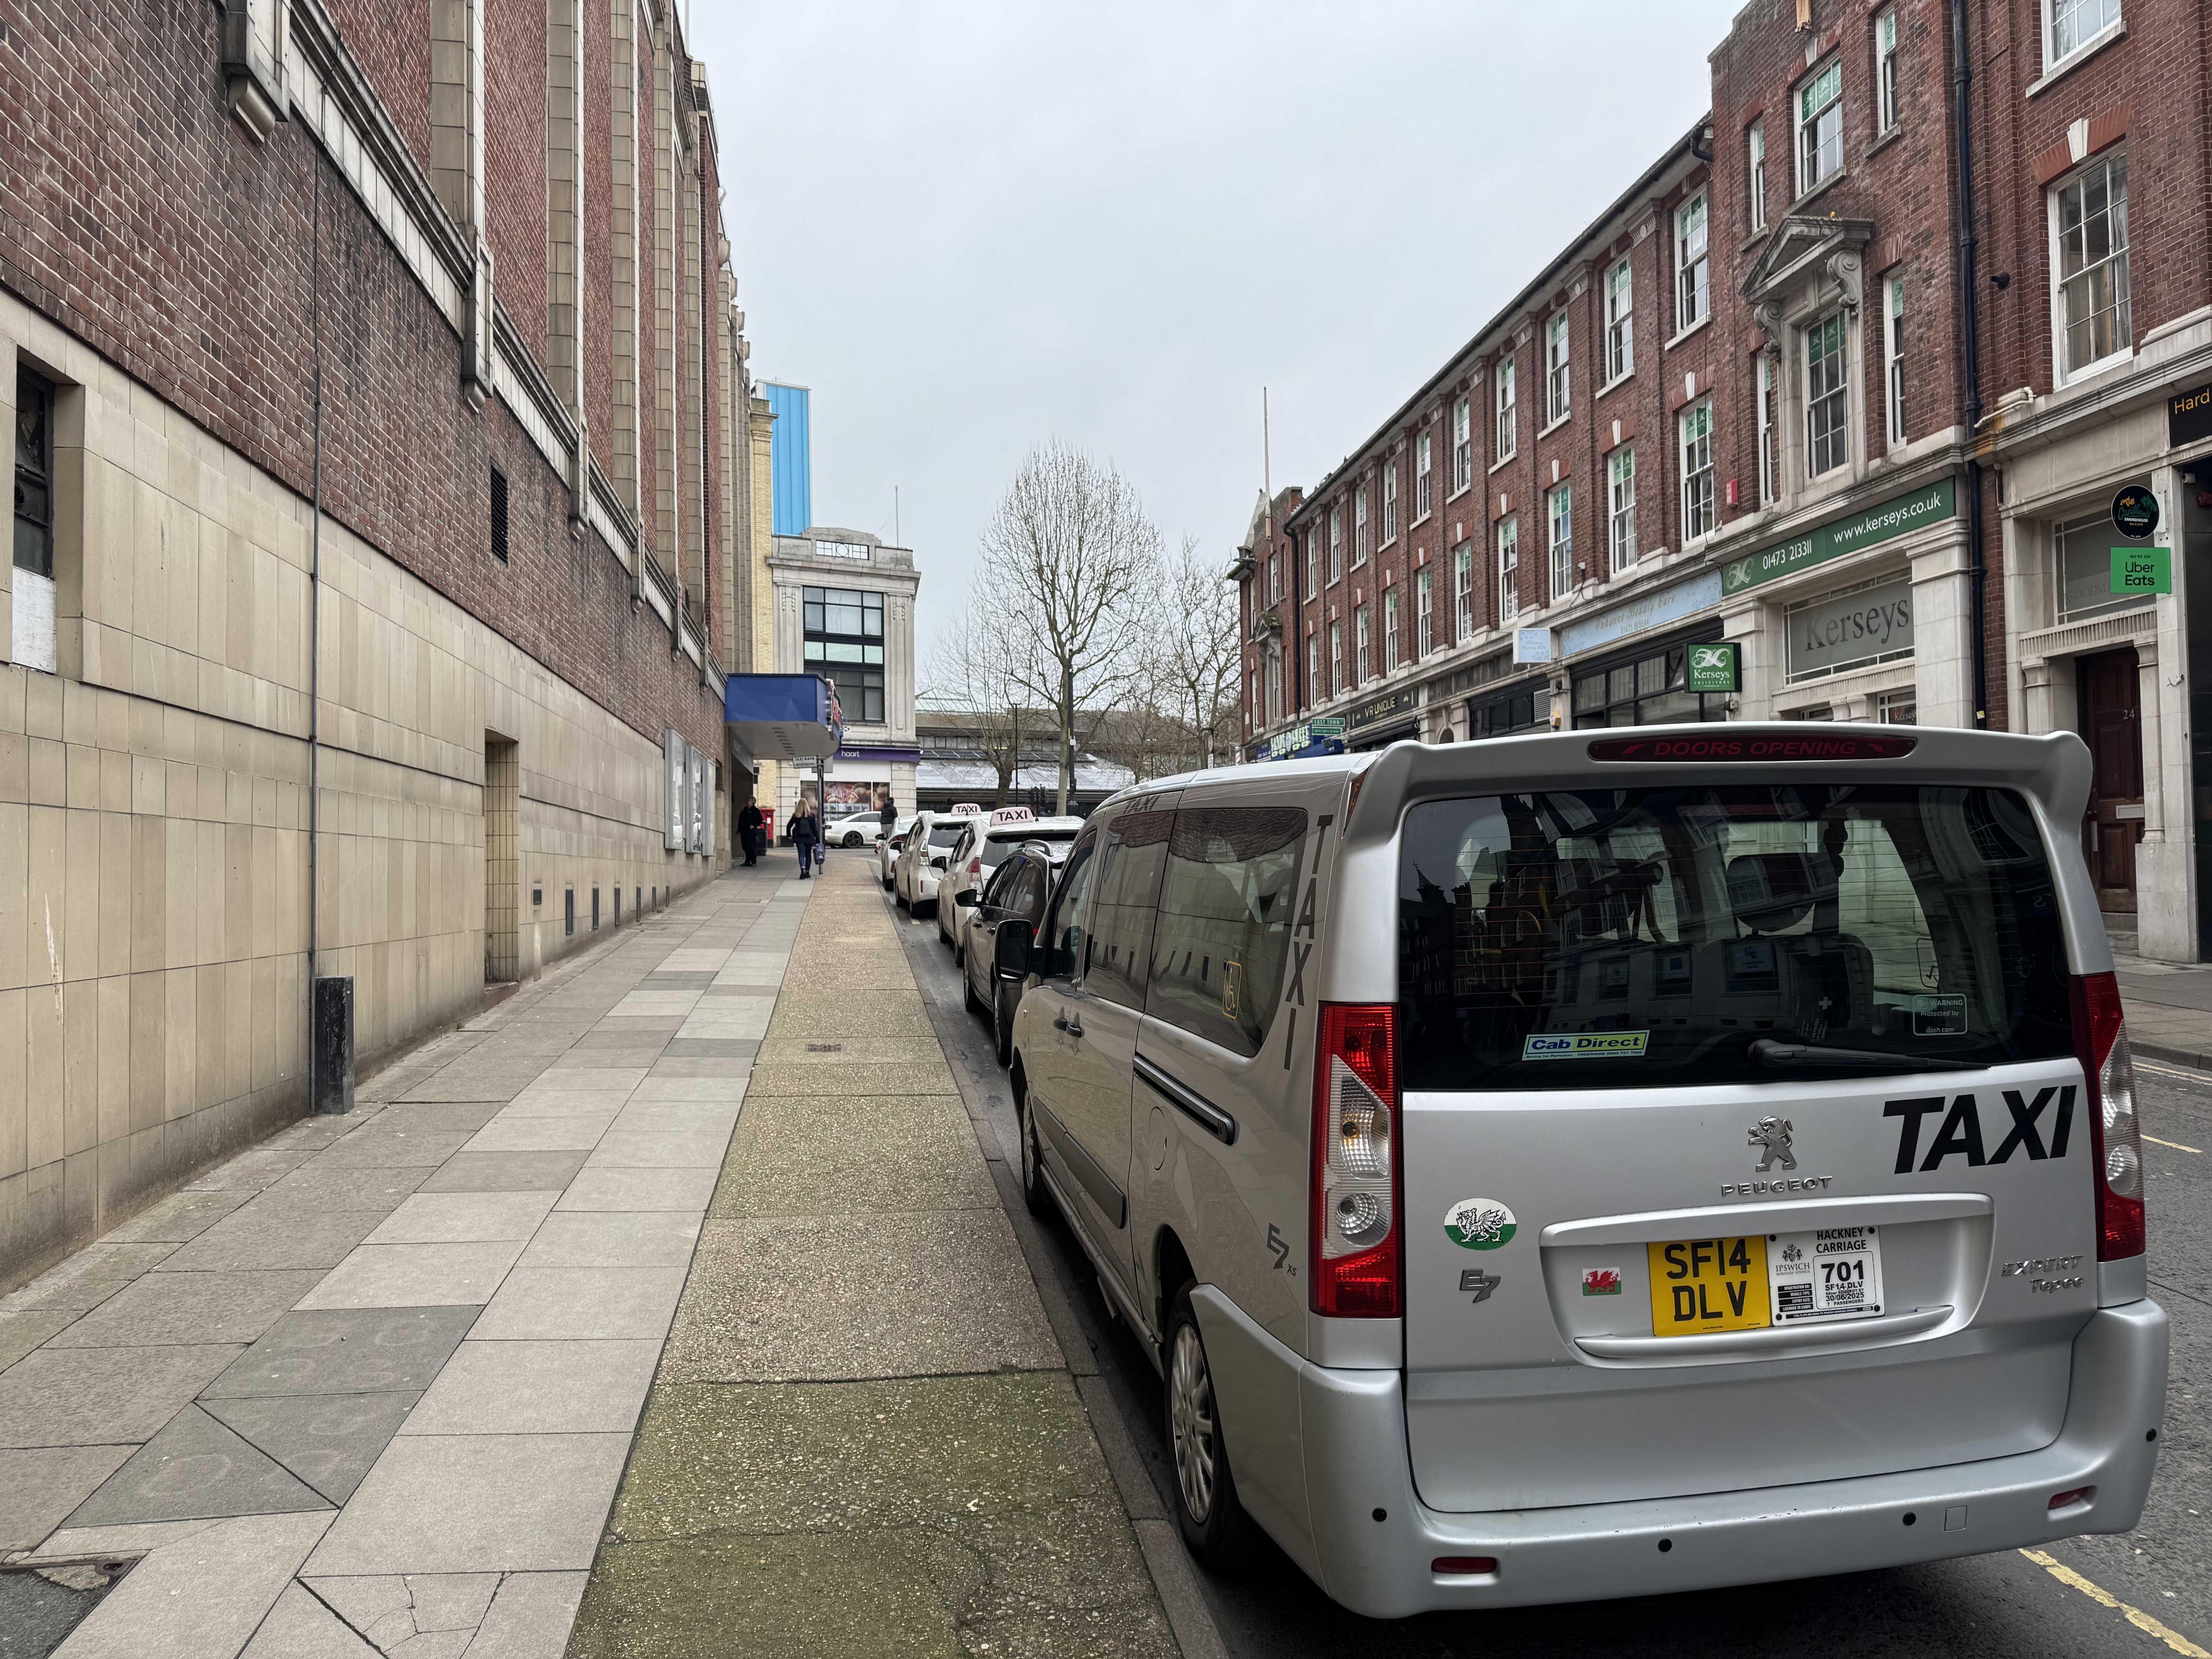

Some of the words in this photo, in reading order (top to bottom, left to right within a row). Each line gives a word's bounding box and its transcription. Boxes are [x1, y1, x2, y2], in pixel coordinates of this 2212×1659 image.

[2174, 388, 2210, 414] Hard
[1834, 492, 1941, 544] www.kerseys.co.uk
[1762, 552, 1786, 570] 01473
[1790, 539, 1812, 560] 213311
[2125, 562, 2155, 573] Uber
[2125, 575, 2155, 586] Eats
[1805, 599, 1909, 652] Kerseys
[1693, 669, 1730, 680] Kerseys
[1894, 711, 1916, 721] Kersey
[2123, 708, 2136, 720] 24
[841, 750, 860, 758] haart
[1654, 742, 1742, 756] DOORS
[1750, 742, 1856, 755] OPENING
[1123, 794, 1161, 814] TAXI
[996, 810, 1028, 821] TAXI
[1283, 814, 1333, 1070] TAXI
[1531, 1039, 1571, 1050] Cab
[1576, 1037, 1640, 1048] Direct
[1882, 1084, 2077, 1175] TAXI
[1721, 1176, 1832, 1197] PEUGEOT
[1817, 1227, 1863, 1241] HACKNEY
[1816, 1240, 1867, 1254] CARRIAGE
[1664, 1238, 1751, 1279] SF14
[2001, 1254, 2084, 1277] EXPERT
[1776, 1262, 1810, 1272] IPSWICH
[1821, 1260, 1864, 1283] 701
[1459, 1268, 1501, 1304] E7
[1825, 1283, 1845, 1291] SF14
[2030, 1277, 2084, 1294] Tepee
[1672, 1280, 1747, 1322] DLV
[1826, 1292, 1865, 1302] 30/06/2025
